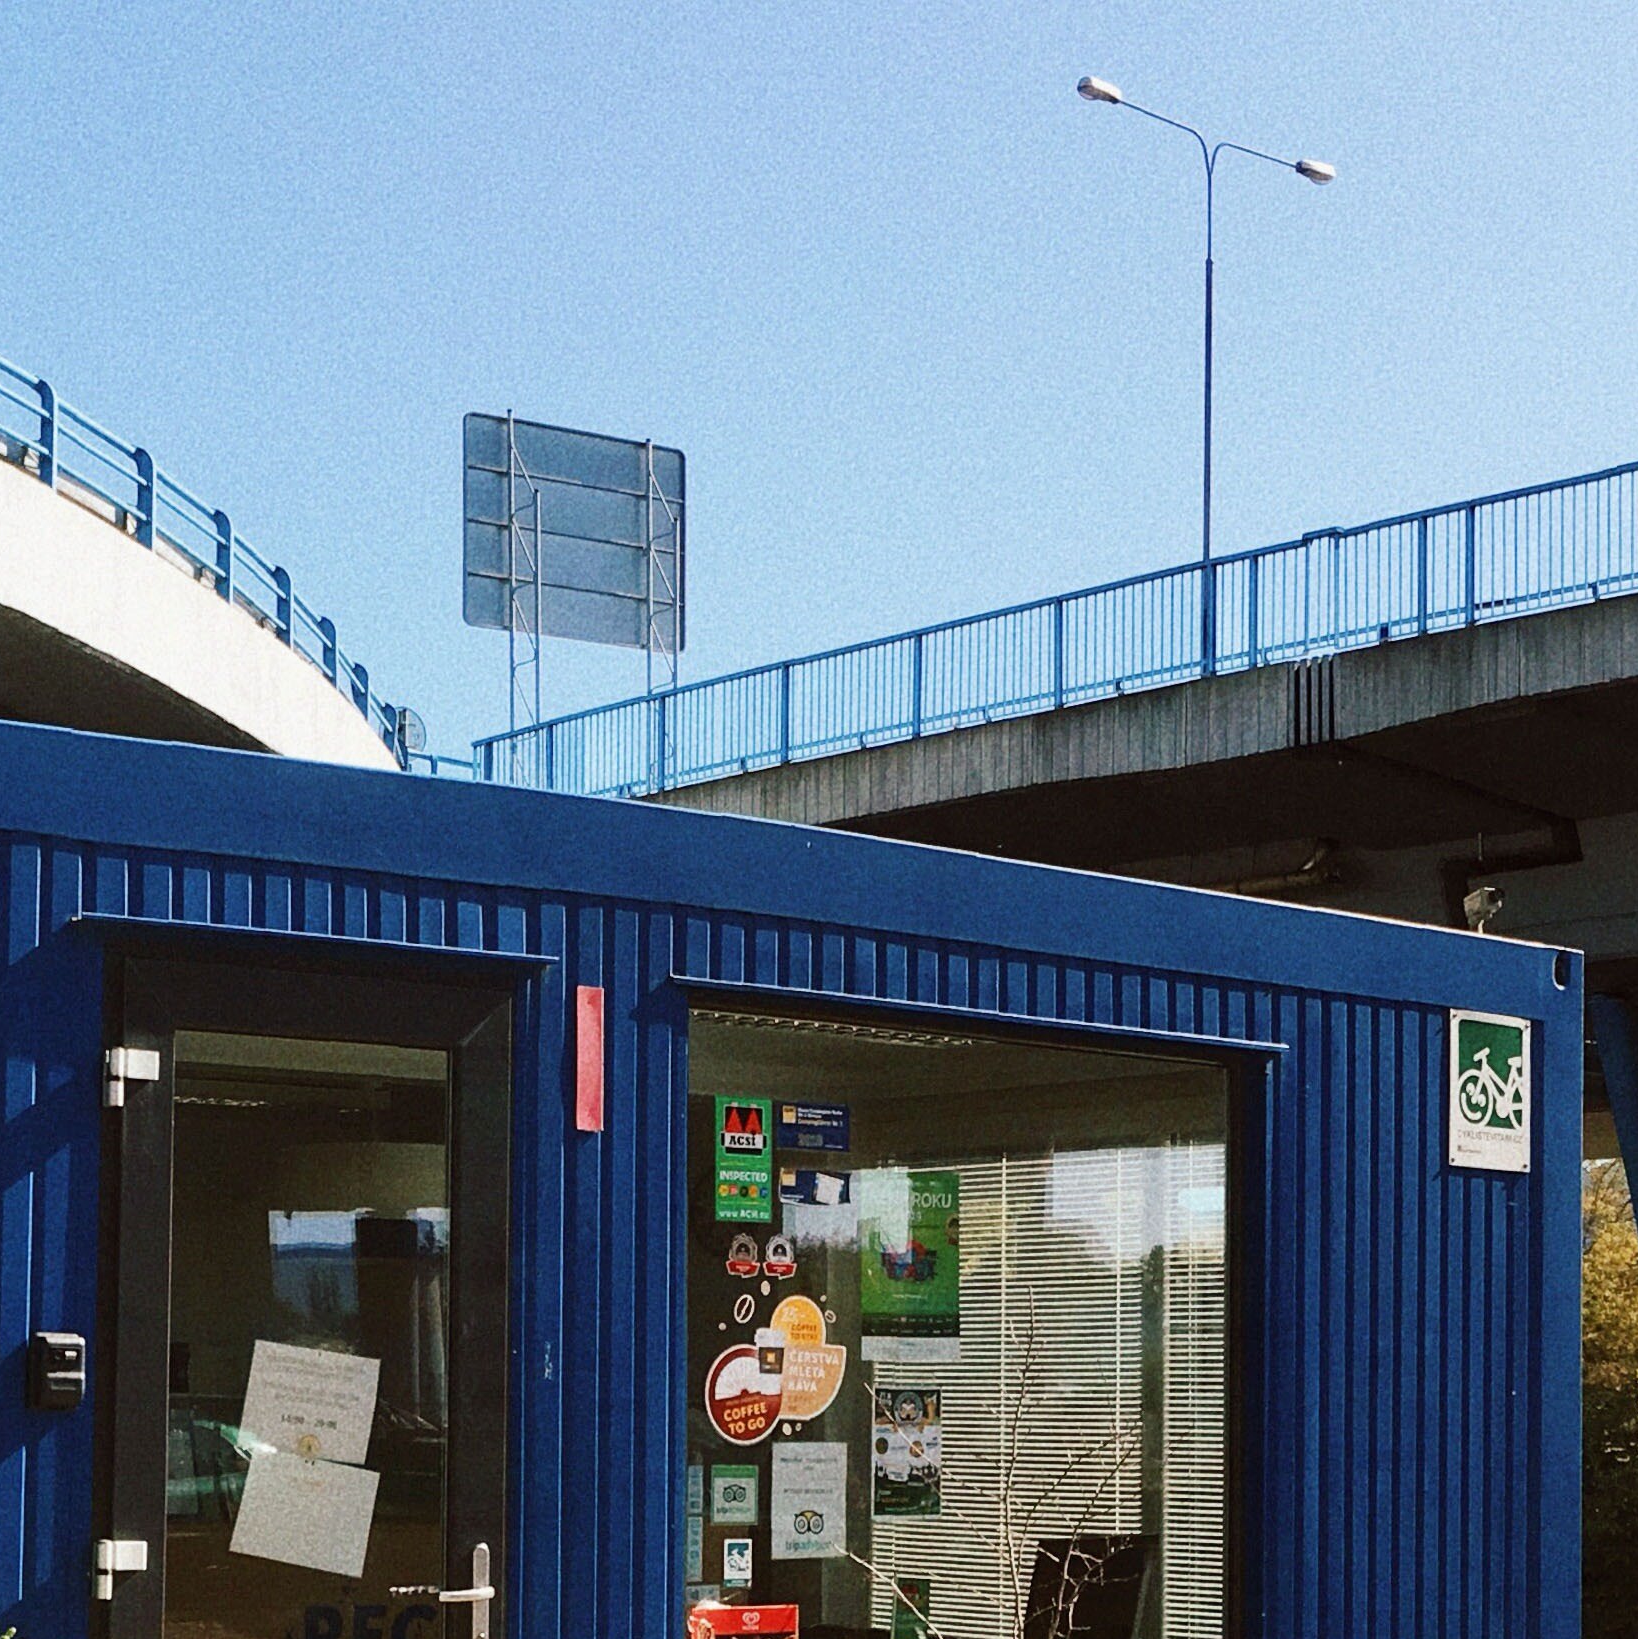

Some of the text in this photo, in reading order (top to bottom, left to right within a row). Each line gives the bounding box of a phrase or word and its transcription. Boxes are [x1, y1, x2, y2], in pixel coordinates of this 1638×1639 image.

[729, 1134, 756, 1146] ACSI
[719, 1170, 768, 1182] INSPECTED
[723, 1402, 768, 1422] COFFEE
[727, 1416, 766, 1435] TO GO
